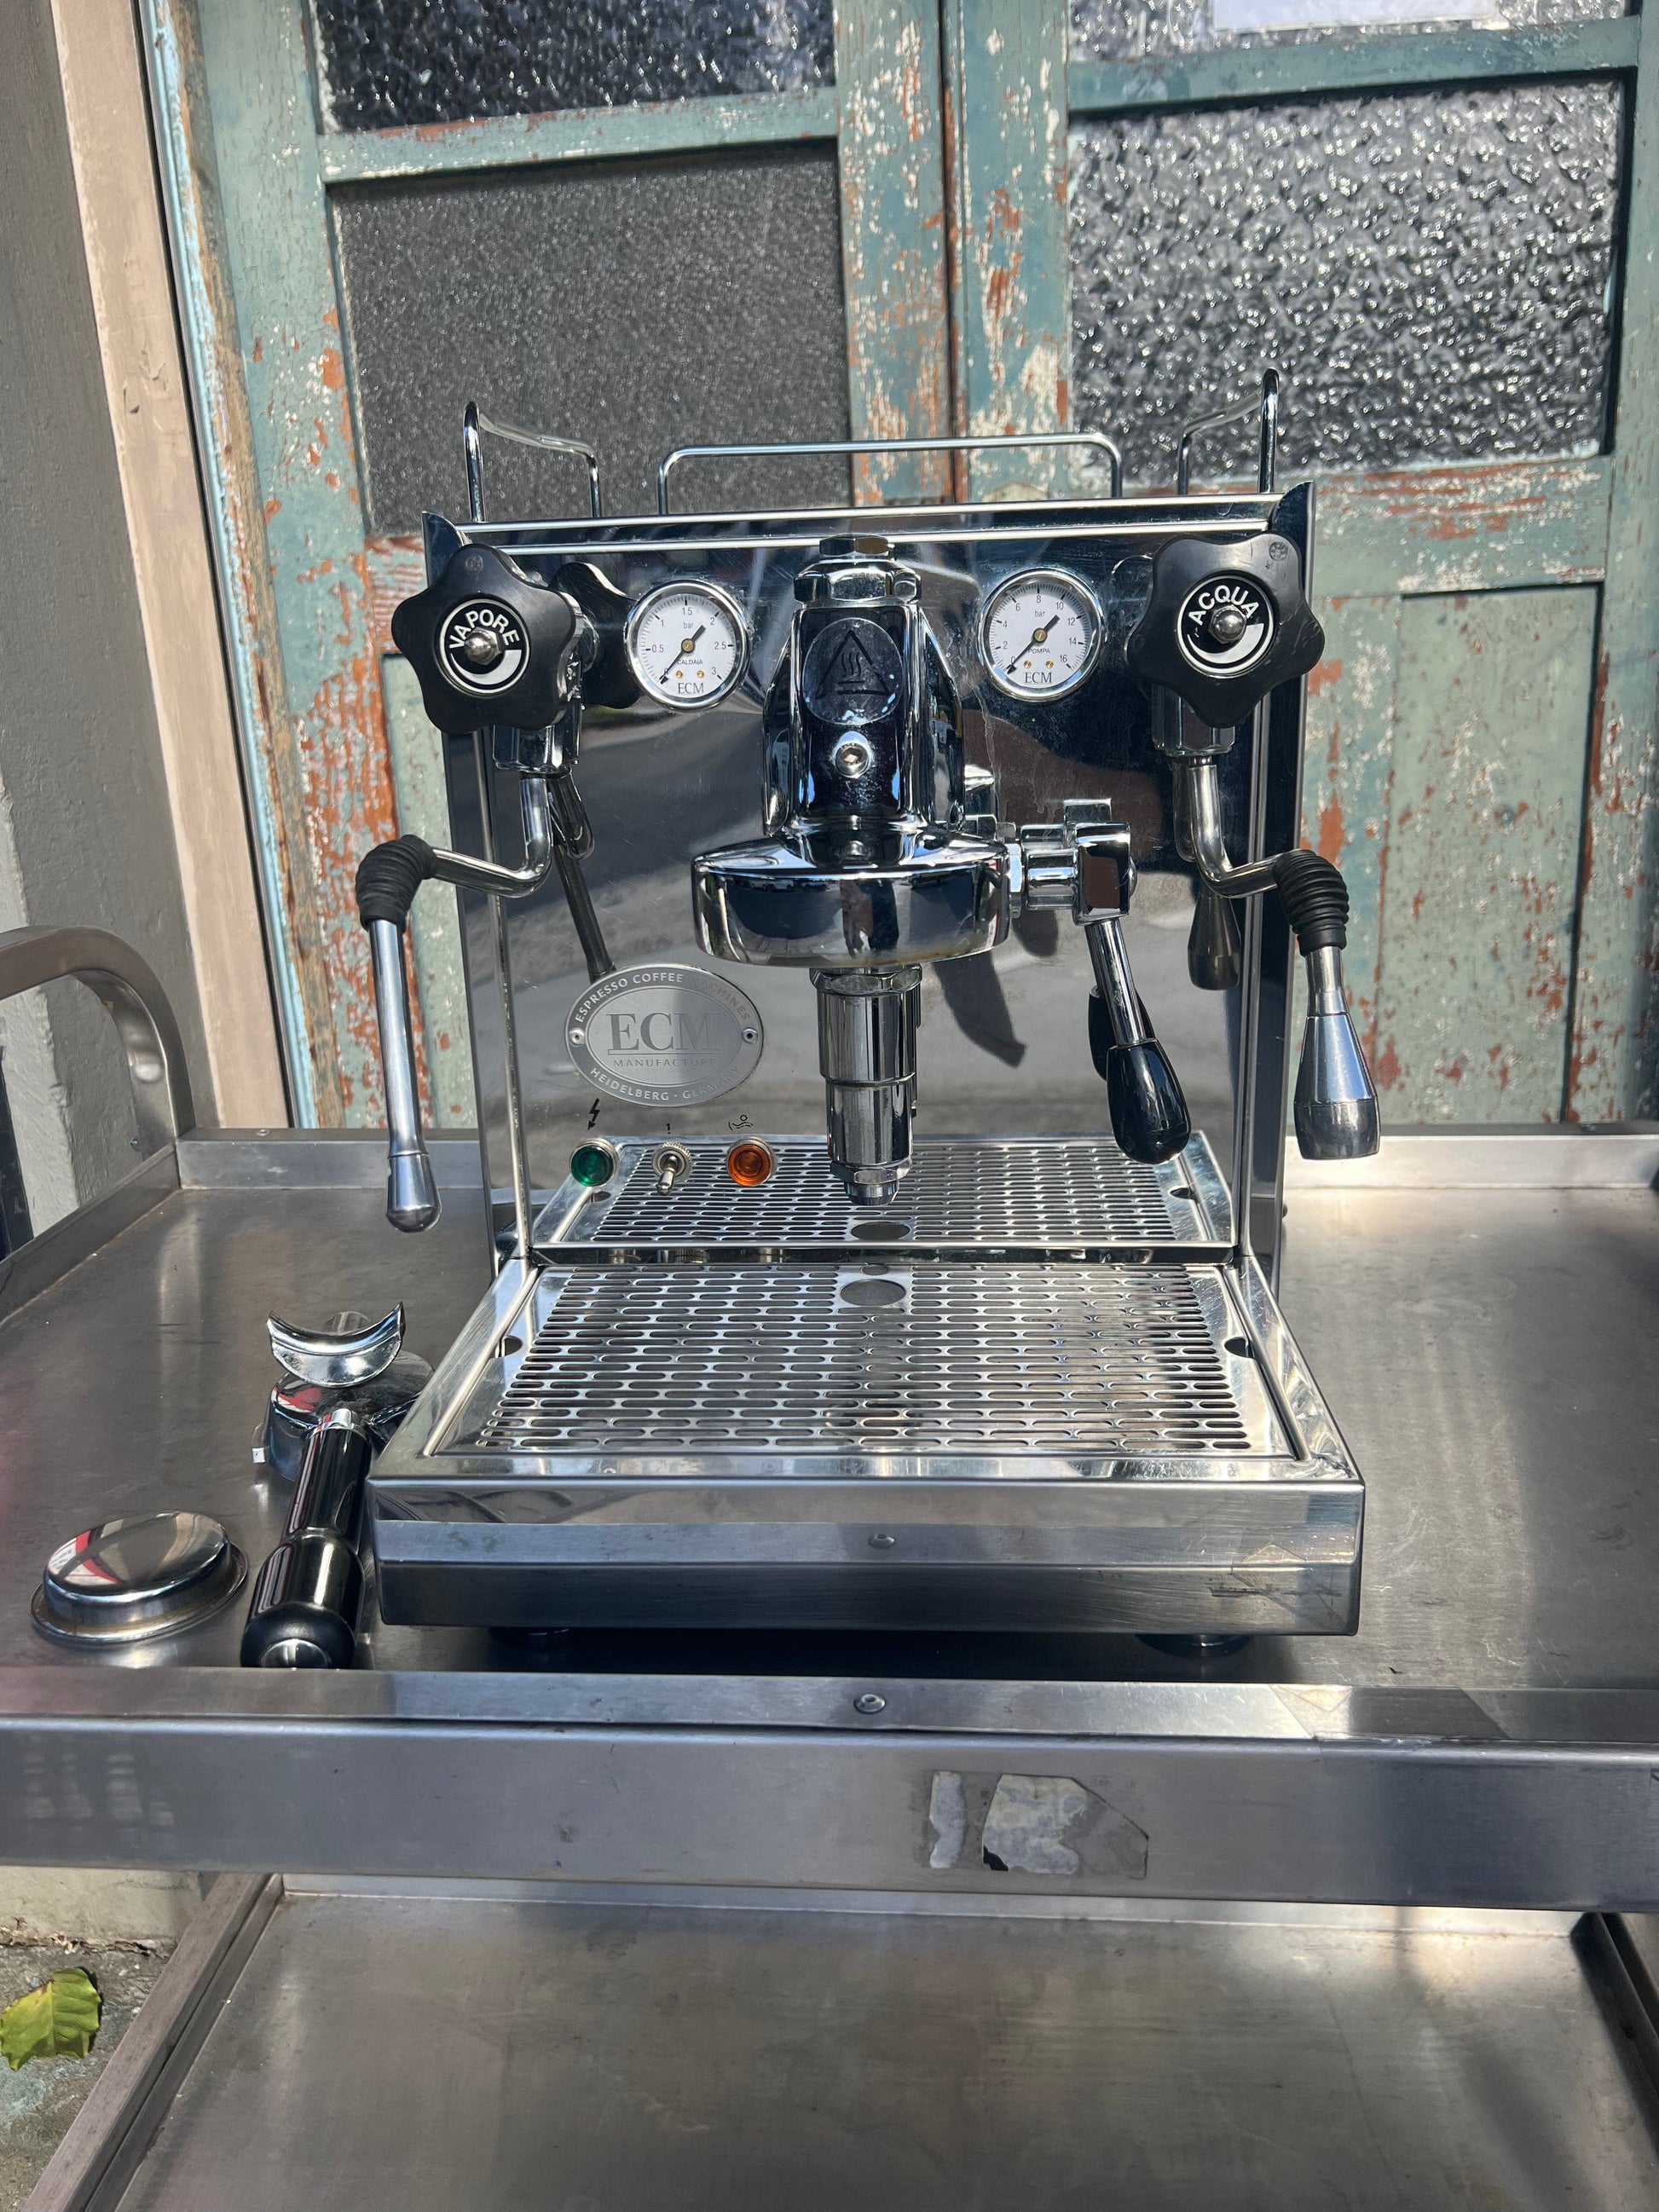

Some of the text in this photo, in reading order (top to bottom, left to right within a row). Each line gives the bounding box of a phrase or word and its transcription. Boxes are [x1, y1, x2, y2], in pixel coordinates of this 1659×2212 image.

[1036, 595, 1042, 604] 8
[1015, 603, 1021, 611] 6
[1055, 602, 1064, 610] 10
[1188, 585, 1260, 627] ACQUA
[709, 617, 715, 626] 2
[1067, 618, 1076, 627] 12
[449, 609, 520, 649] VAPORE
[651, 644, 664, 653] 0.5
[714, 641, 726, 650] 2.5
[1003, 641, 1008, 650] 2
[1060, 655, 1067, 663] 16
[711, 667, 716, 675] 3
[1025, 672, 1053, 684] ECM
[678, 682, 704, 695] ECM
[575, 978, 628, 1023] ESPRESSO
[633, 973, 685, 984] COFFEE
[606, 1011, 723, 1051] ECM
[614, 1058, 717, 1067] MANUFACTURE
[590, 1067, 669, 1101] HEIDELBERG
